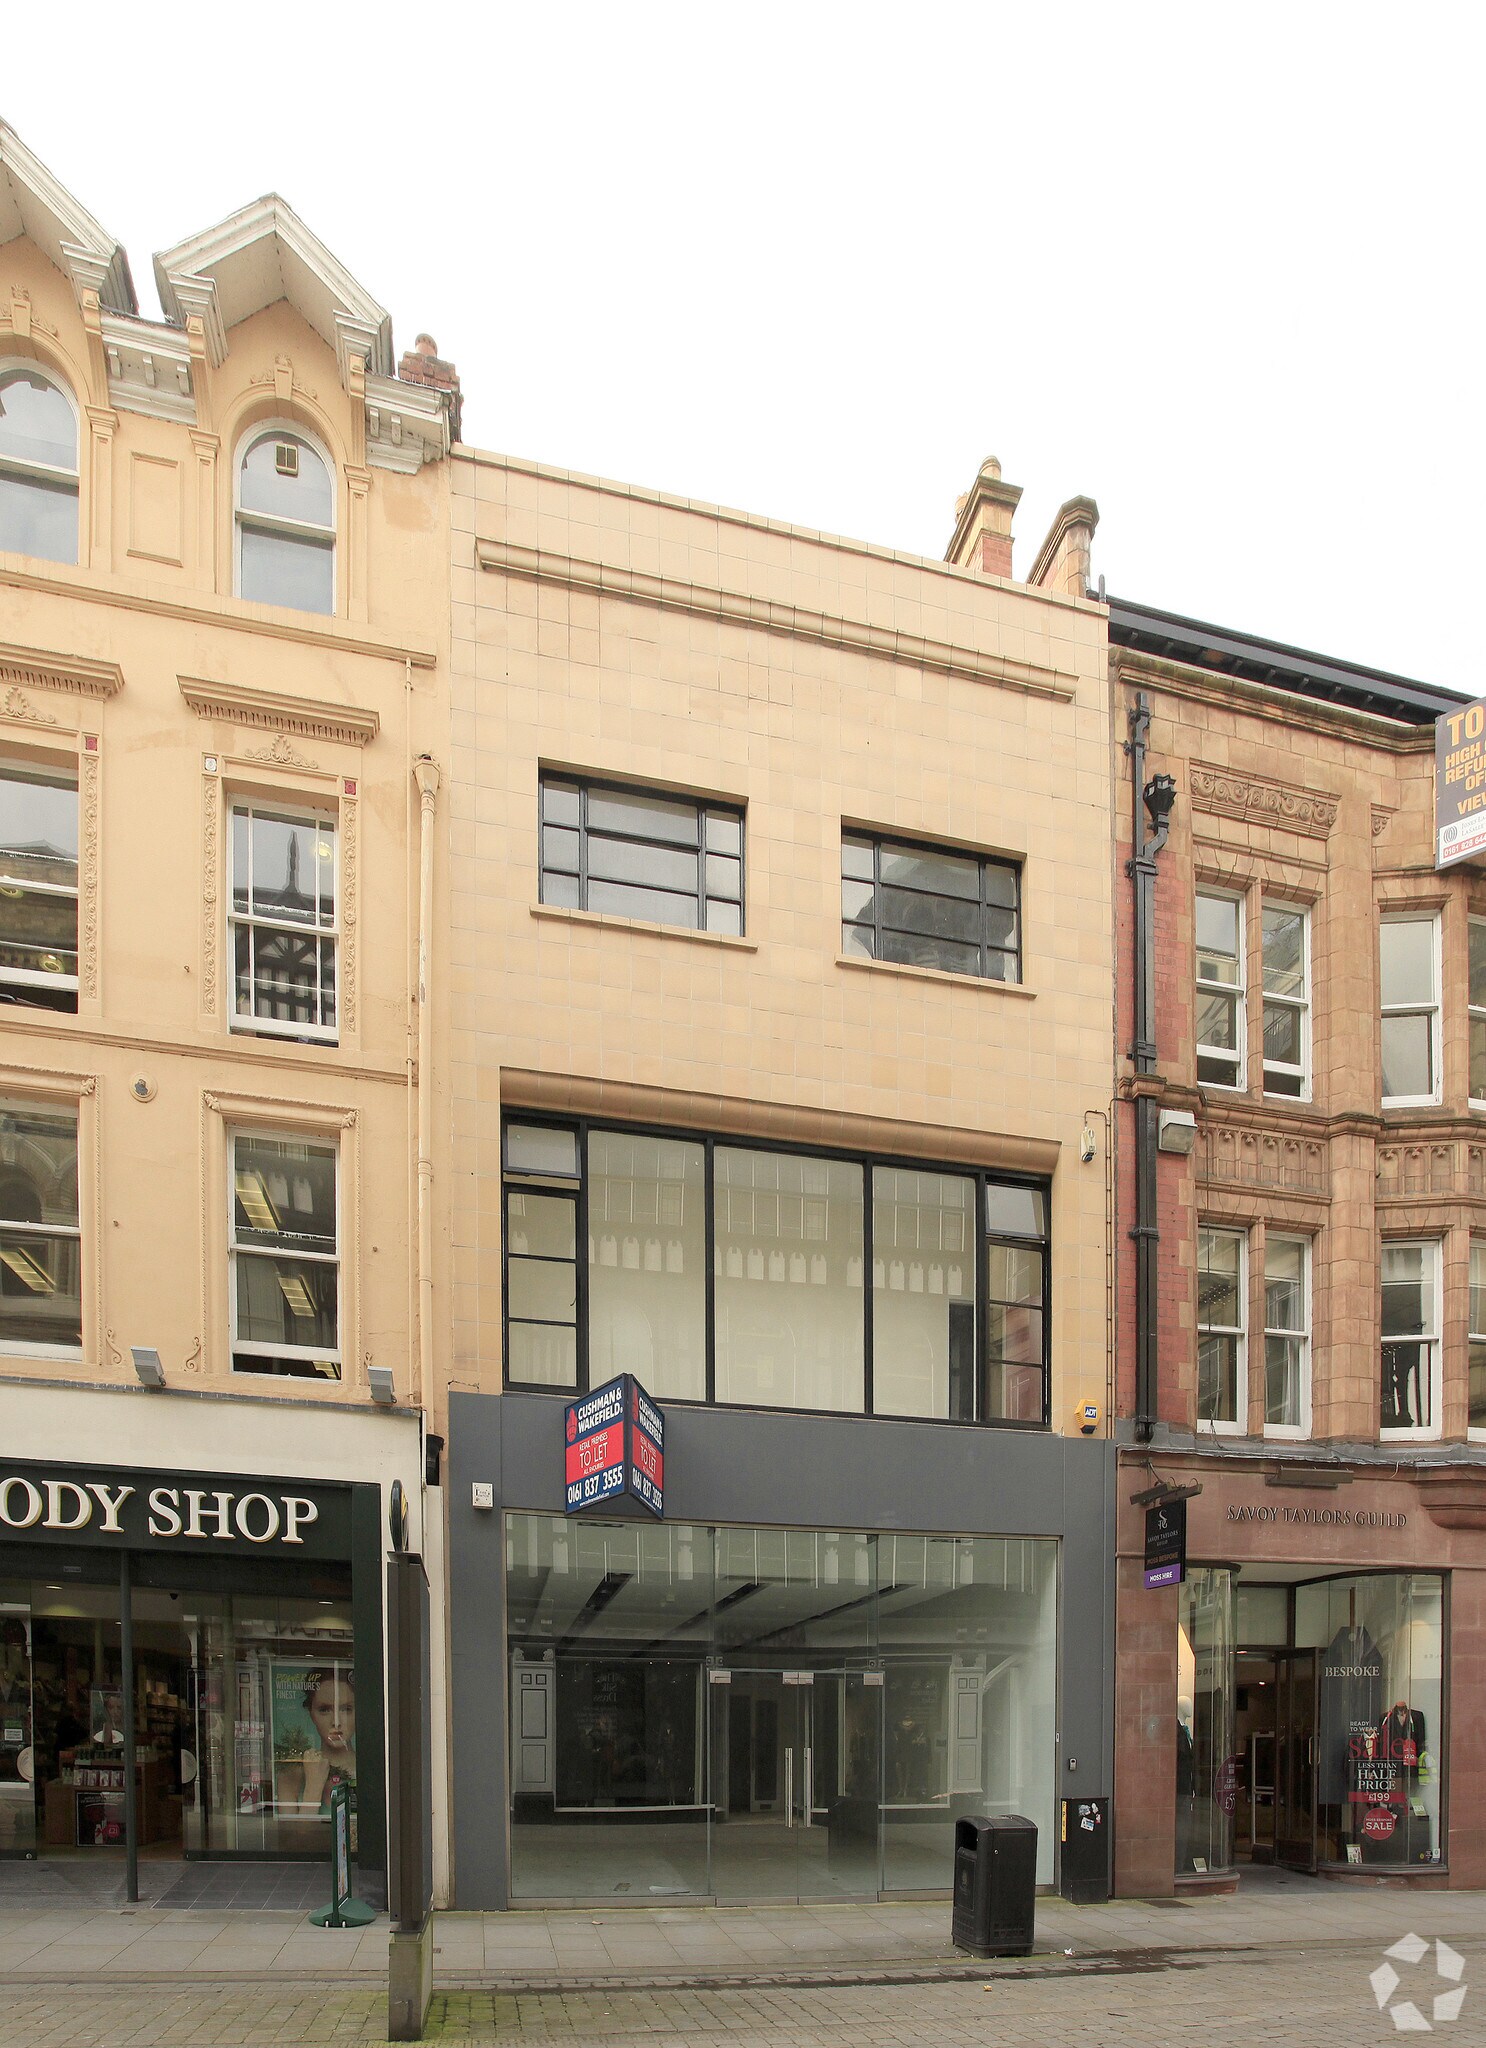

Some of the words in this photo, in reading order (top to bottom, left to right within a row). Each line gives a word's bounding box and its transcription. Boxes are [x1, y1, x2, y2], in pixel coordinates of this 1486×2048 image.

[1447, 705, 1484, 747] TO
[1445, 742, 1481, 770] HIGH
[578, 1390, 615, 1420] CUSHMAN
[616, 1387, 622, 1400] &
[1085, 1408, 1096, 1417] ADT
[580, 1441, 591, 1451] RETAIL
[591, 1432, 608, 1445] PREMISES
[580, 1450, 591, 1468] TO
[594, 1442, 608, 1462] LET
[640, 1445, 648, 1465] TO
[648, 1456, 656, 1474] LET
[568, 1482, 582, 1504] 0161
[584, 1475, 599, 1497] 837
[602, 1466, 623, 1490] 3555
[0, 1477, 136, 1533] ODY
[148, 1487, 318, 1544] SHOP
[1226, 1504, 1278, 1521] SAVOY
[1281, 1507, 1350, 1524] TAYLORS
[1354, 1511, 1407, 1527] GUILD
[1149, 1573, 1161, 1582] MOSS
[1161, 1571, 1173, 1580] HIRE
[1325, 1666, 1380, 1677] BESPOKE
[276, 1673, 307, 1682] POWER
[308, 1673, 321, 1682] UP
[276, 1682, 291, 1690] WITH
[292, 1682, 321, 1691] NATURE'S
[276, 1690, 296, 1700] FINEST
[1357, 1769, 1397, 1779] HALF
[1357, 1780, 1396, 1790] PRICE
[1368, 1792, 1390, 1801] £199
[1366, 1822, 1392, 1830] SALE
